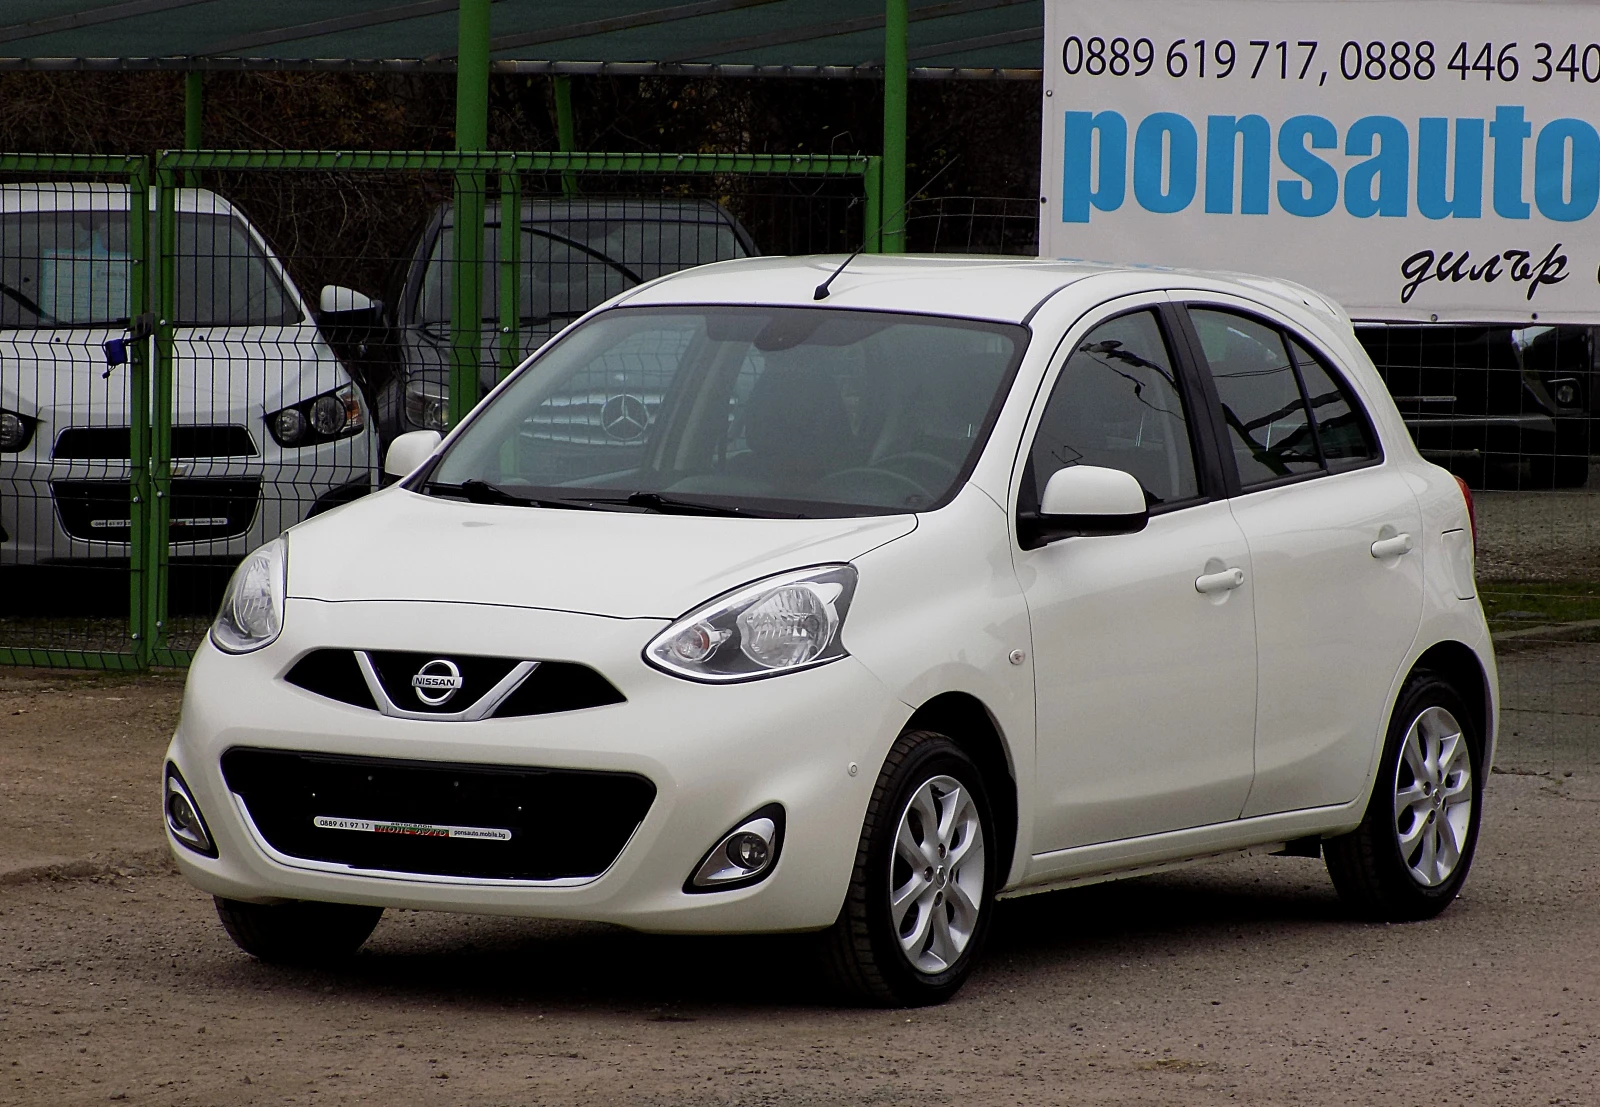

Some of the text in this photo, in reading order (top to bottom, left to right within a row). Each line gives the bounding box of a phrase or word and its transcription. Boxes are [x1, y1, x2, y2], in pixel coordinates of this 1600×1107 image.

[1062, 35, 1600, 87] 0889 619 717, 0888 446 340
[1062, 106, 1600, 223] ponsauto
[1401, 243, 1570, 304] дилър
[415, 677, 456, 687] NISSAN
[453, 830, 506, 839] ponsauto.mobile.bg
